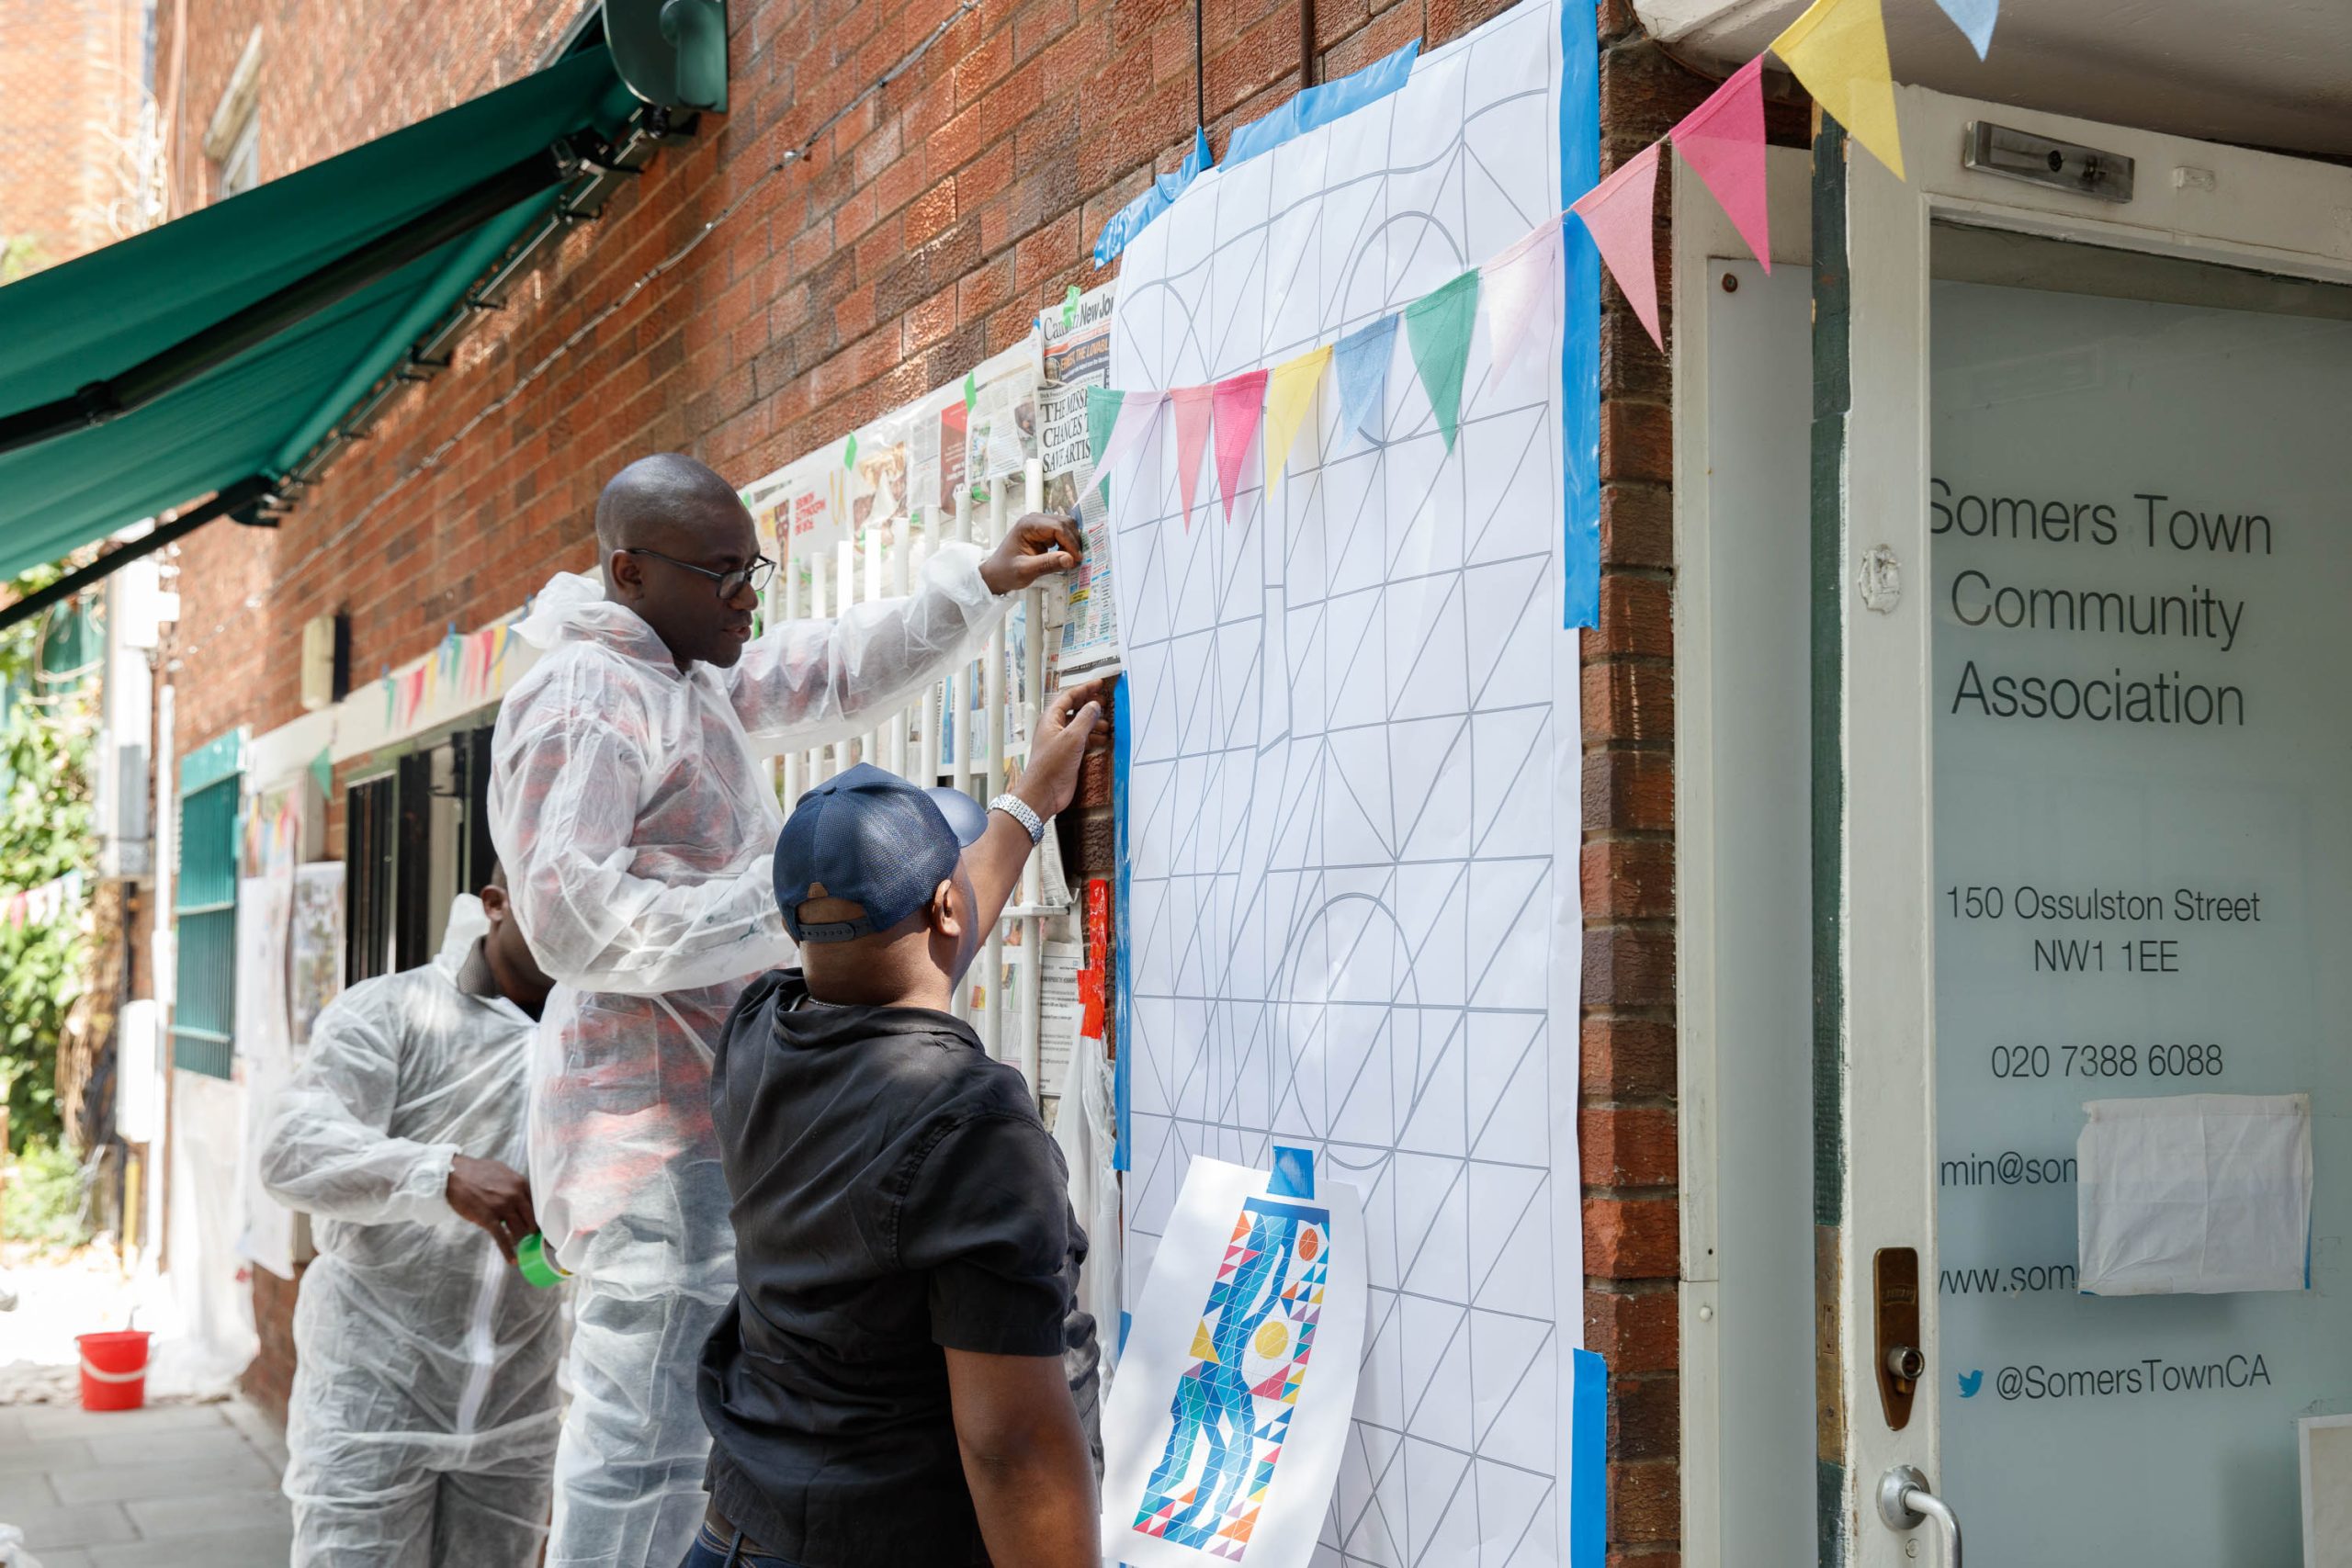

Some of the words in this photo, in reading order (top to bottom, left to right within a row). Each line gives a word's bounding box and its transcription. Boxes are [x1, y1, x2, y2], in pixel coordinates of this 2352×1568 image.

[1044, 314, 1080, 342] Camn
[1080, 302, 1100, 327] New
[1039, 399, 1066, 423] THE
[1043, 414, 1082, 448] CHANCES
[1930, 478, 2118, 546] Somers
[2134, 493, 2272, 555] Town
[1951, 570, 2245, 651] Community
[1951, 660, 2244, 726] Association
[1947, 886, 2004, 919] 150
[2015, 886, 2163, 919] Ossulston
[2175, 888, 2261, 921] Street
[2034, 940, 2103, 972] NW1
[2121, 940, 2179, 972] 1EE
[1992, 1045, 2050, 1077] 020
[2062, 1044, 2137, 1077] 7388
[2149, 1044, 2223, 1077] 6088
[1939, 1265, 2075, 1294] ww.som
[1996, 1354, 2271, 1400] @SomersTownCA
